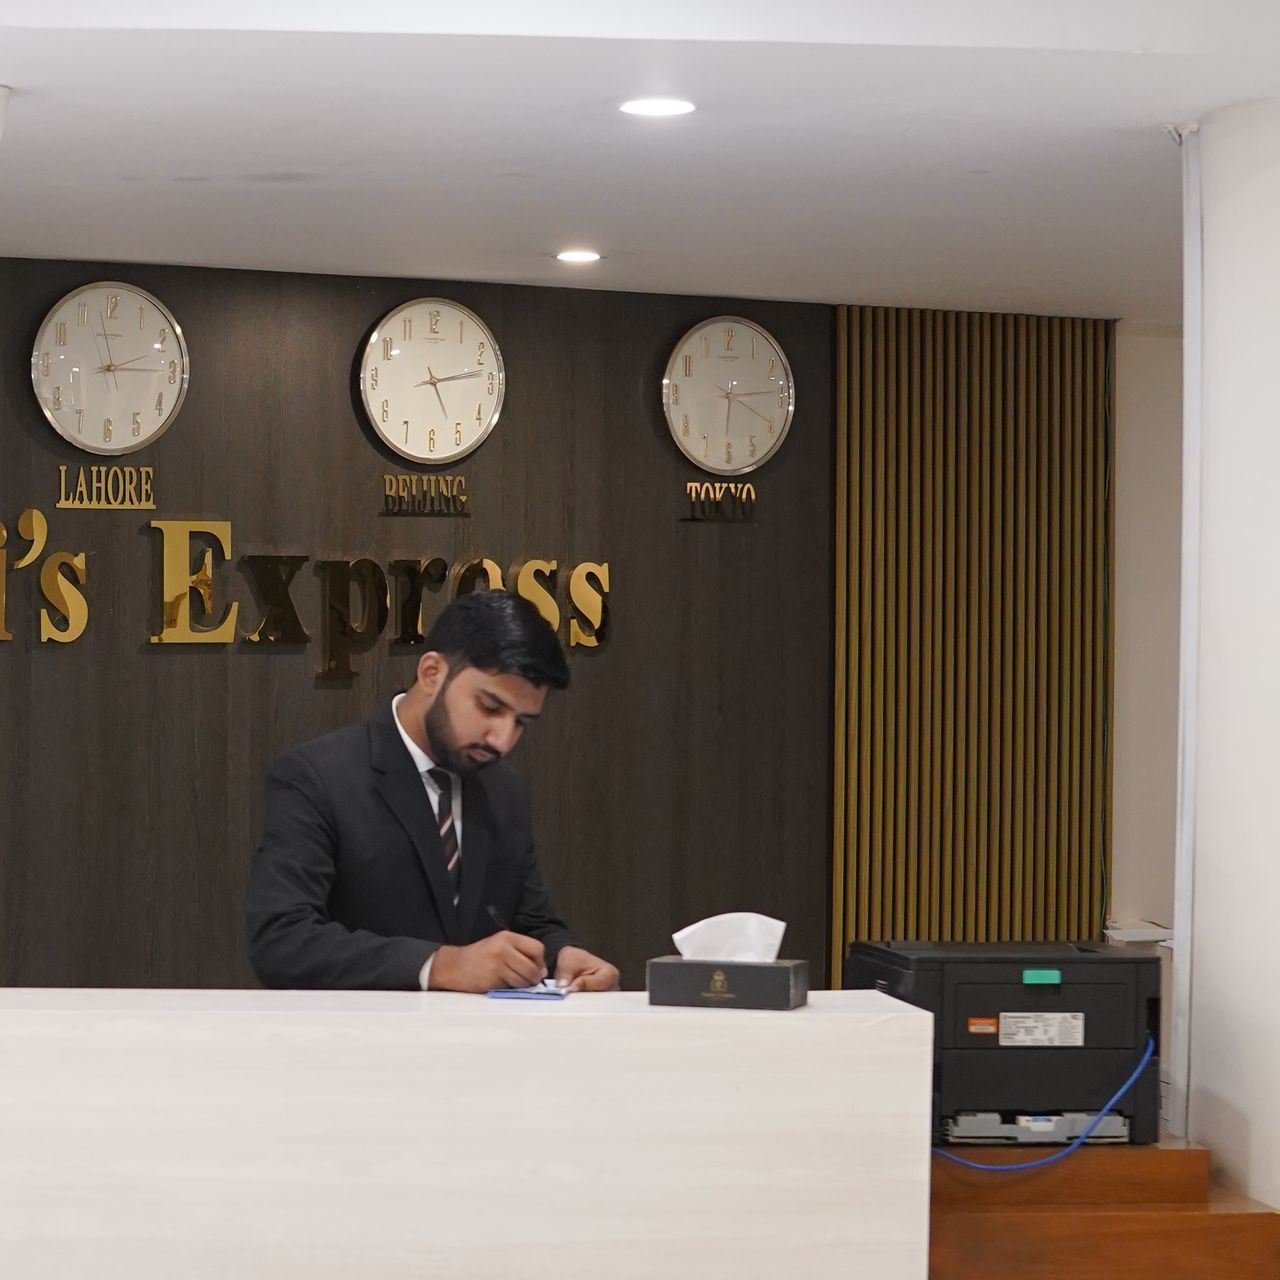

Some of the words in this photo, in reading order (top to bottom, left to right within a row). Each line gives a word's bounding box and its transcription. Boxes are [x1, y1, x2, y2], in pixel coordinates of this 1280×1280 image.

[107, 296, 120, 319] 12
[139, 305, 144, 329] 1
[158, 329, 168, 352] 2
[403, 318, 412, 341] 11
[459, 321, 463, 343] 1
[725, 328, 734, 351] 12
[477, 342, 485, 365] 2
[752, 337, 756, 359] 1
[769, 357, 775, 380] 2
[155, 392, 163, 416] 4
[476, 403, 482, 427] 4
[76, 409, 84, 433] 7
[132, 412, 142, 437] 5
[403, 421, 408, 444] 7
[429, 429, 435, 452] 6
[455, 423, 462, 446] 5
[57, 465, 155, 508] LAHORE
[383, 475, 468, 514] BEIJING
[686, 482, 756, 519] TOKYO
